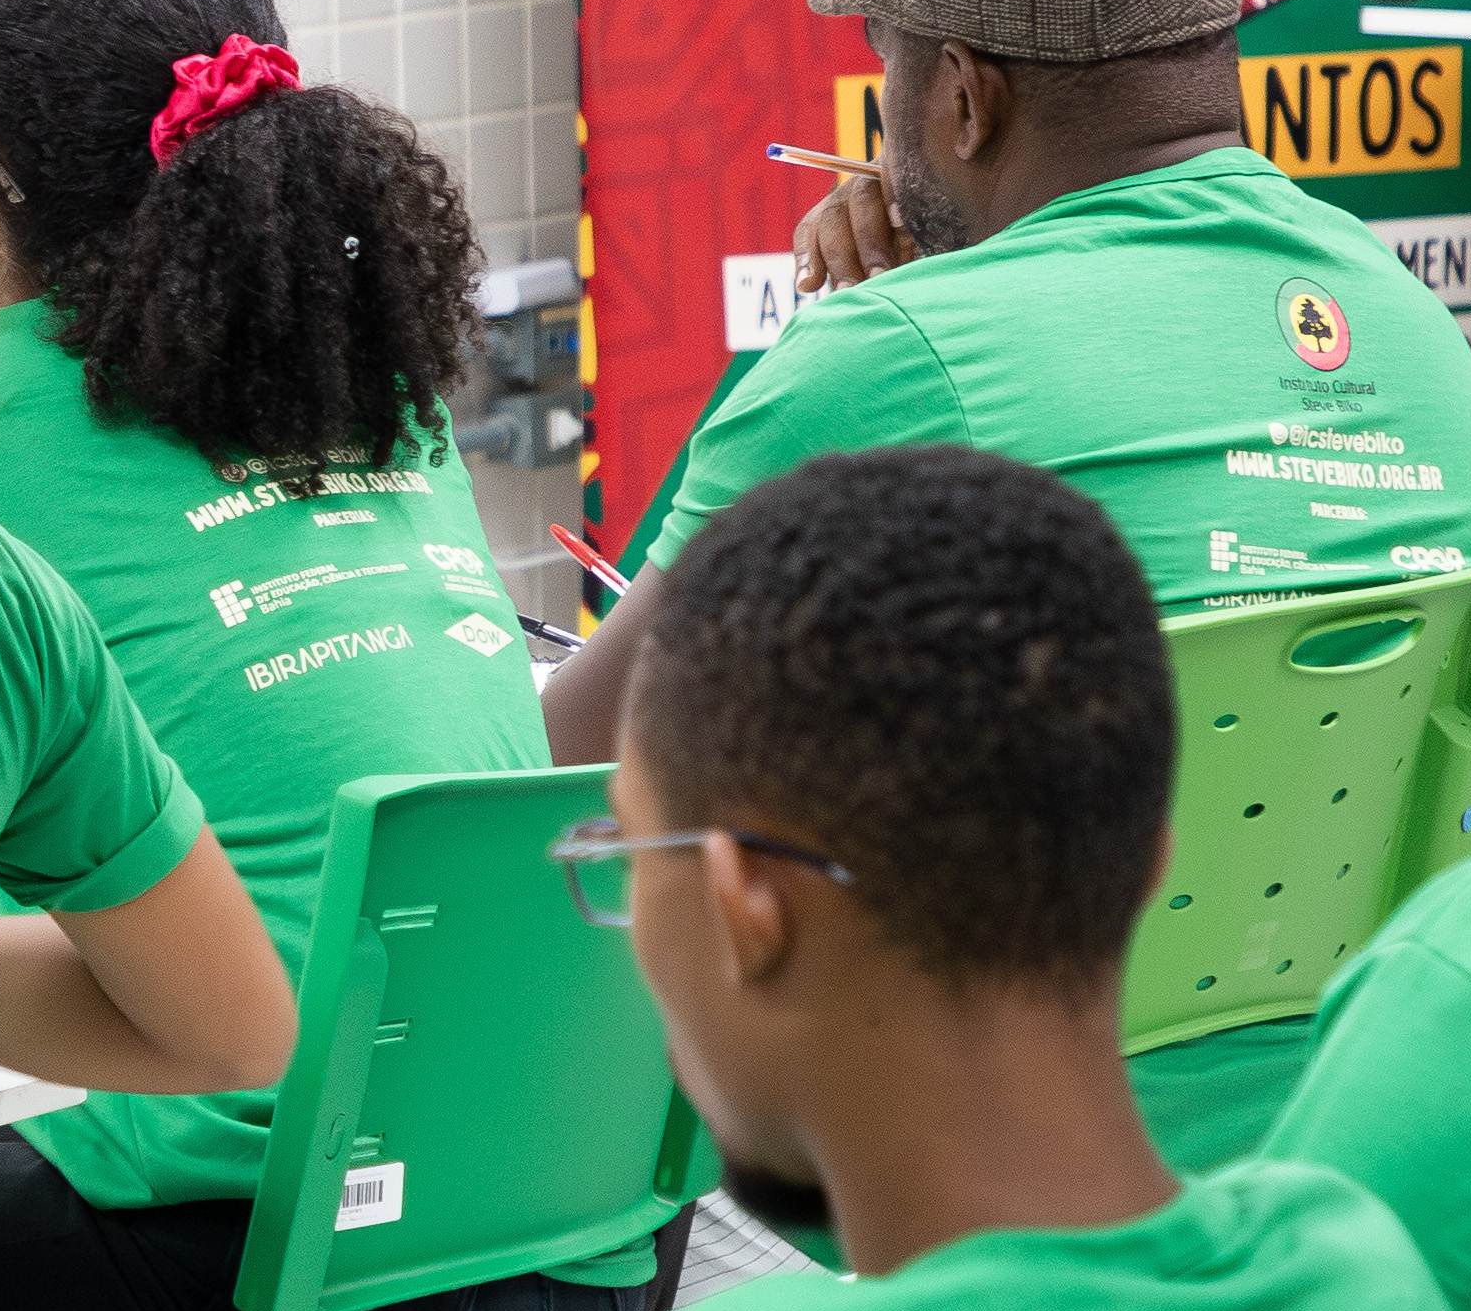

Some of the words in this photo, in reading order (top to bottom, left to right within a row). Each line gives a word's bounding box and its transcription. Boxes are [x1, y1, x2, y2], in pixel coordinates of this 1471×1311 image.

[1245, 57, 1446, 166] NTOS
[1279, 376, 1330, 393] Instituto
[1332, 379, 1376, 395] Cultural
[1302, 397, 1335, 413] Steve
[1337, 399, 1363, 413] Biko
[1289, 424, 1405, 455] @icstevebiko
[1225, 449, 1445, 491] WWW.STEVEBIKO.ORG.BR
[185, 471, 434, 532] WWW.STBIKO.ORG.BR
[313, 509, 378, 528] PARCERIAS:
[250, 572, 300, 595] INSTITUTO
[254, 593, 270, 605] DE
[259, 597, 293, 615] Bahia
[243, 623, 414, 692] IBIRAPITANGA
